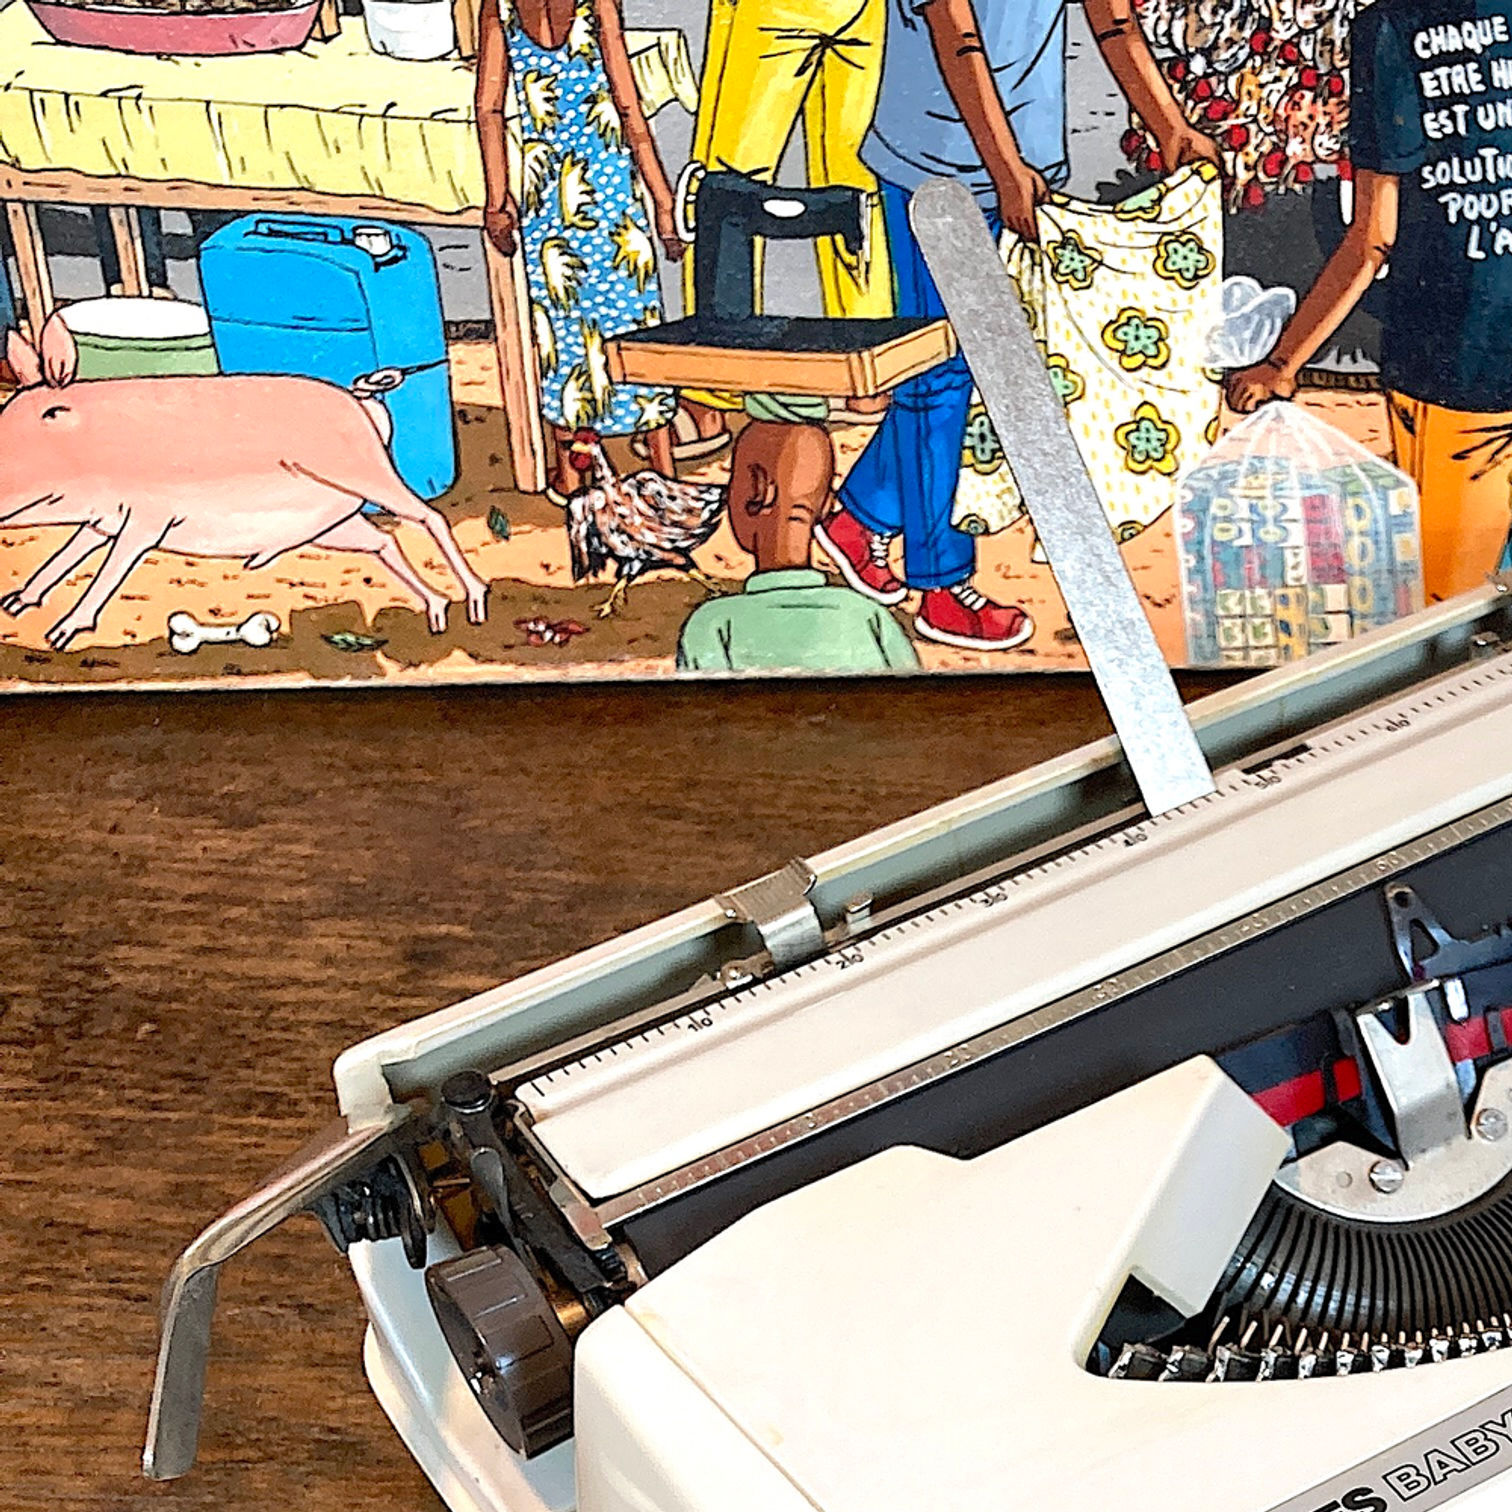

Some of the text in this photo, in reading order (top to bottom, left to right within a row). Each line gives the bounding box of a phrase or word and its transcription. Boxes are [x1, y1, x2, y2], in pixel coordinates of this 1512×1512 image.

[1413, 16, 1509, 59] CHAQUE
[1419, 62, 1486, 98] ETRE
[1422, 103, 1471, 139] EST
[838, 953, 866, 971] 20
[687, 1016, 714, 1033] 10
